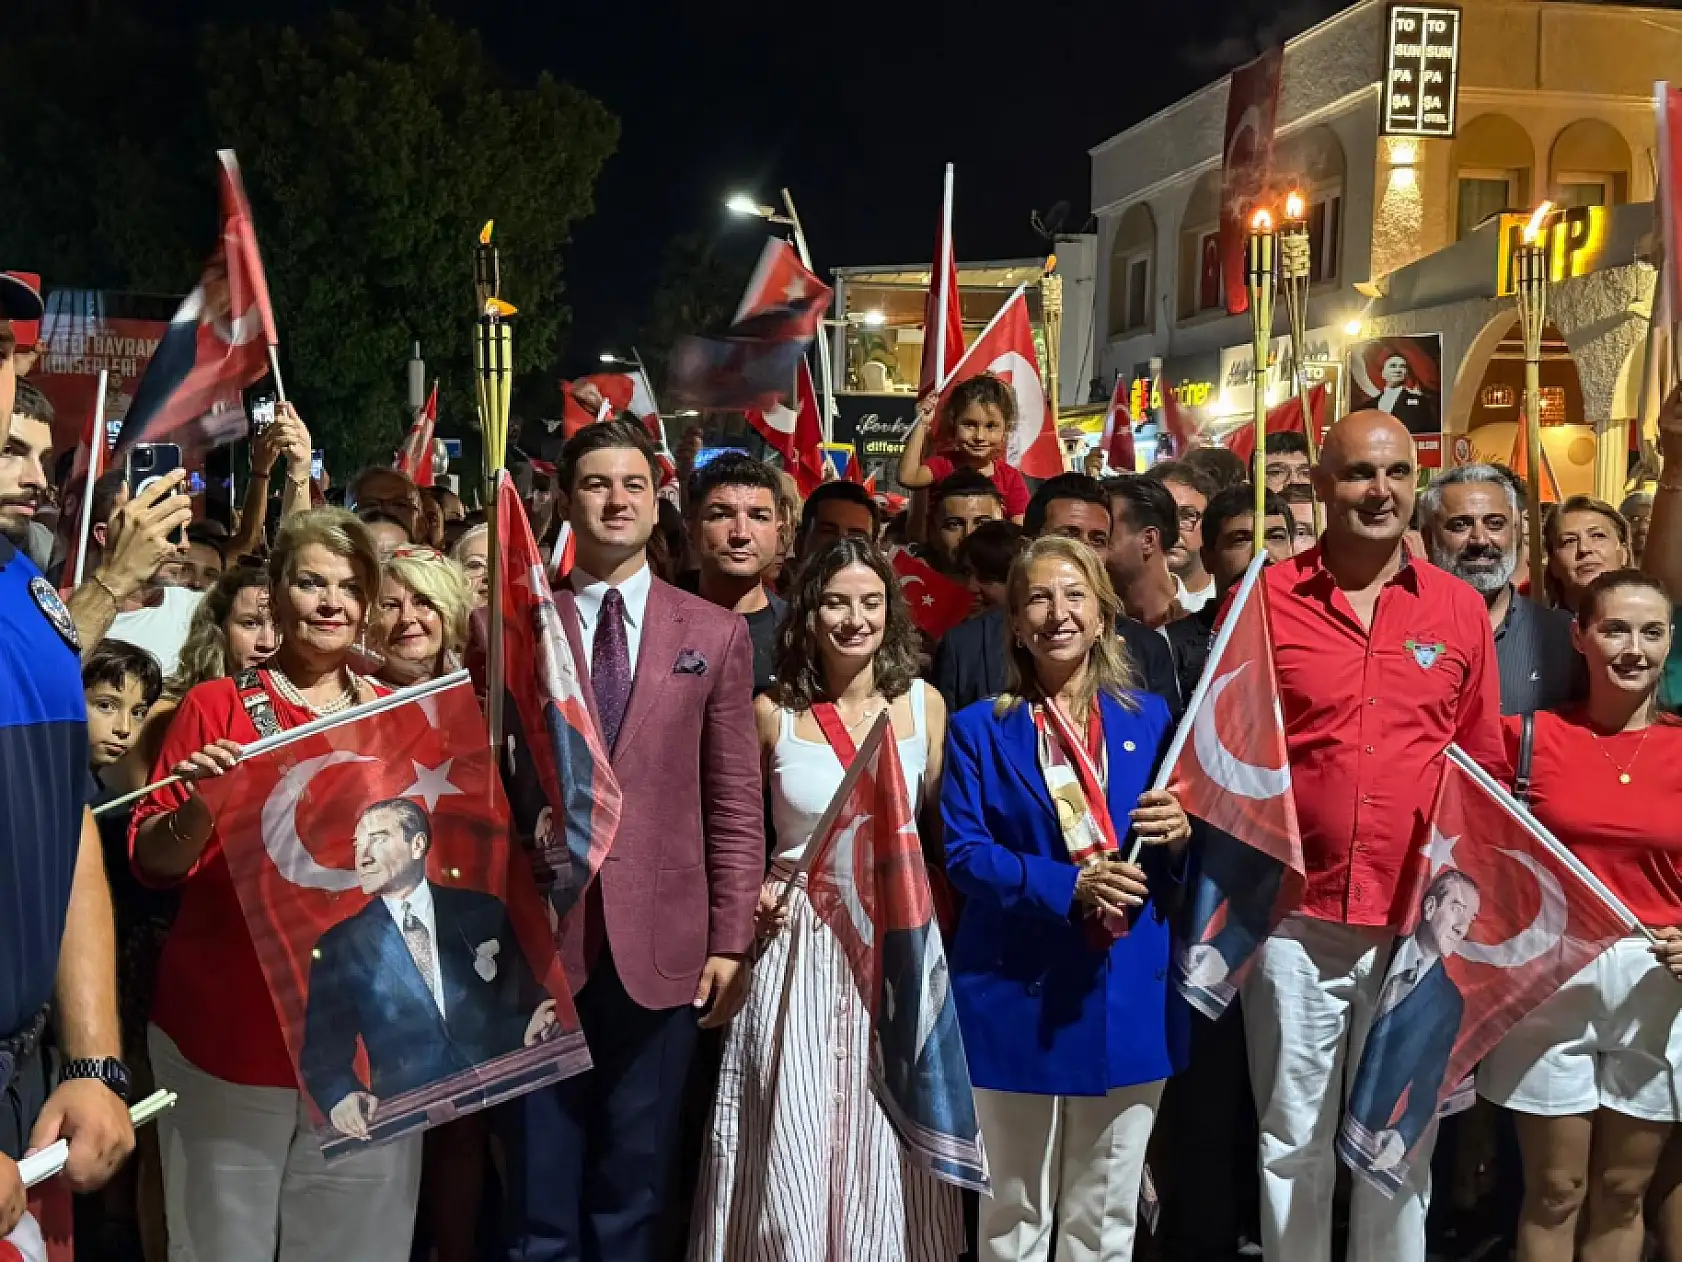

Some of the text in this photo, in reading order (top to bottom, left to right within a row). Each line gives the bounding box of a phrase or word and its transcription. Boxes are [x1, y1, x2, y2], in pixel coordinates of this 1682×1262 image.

[1396, 18, 1415, 32] TO
[1427, 20, 1447, 33] TO
[1393, 69, 1412, 82] PA
[1424, 70, 1443, 83] PA
